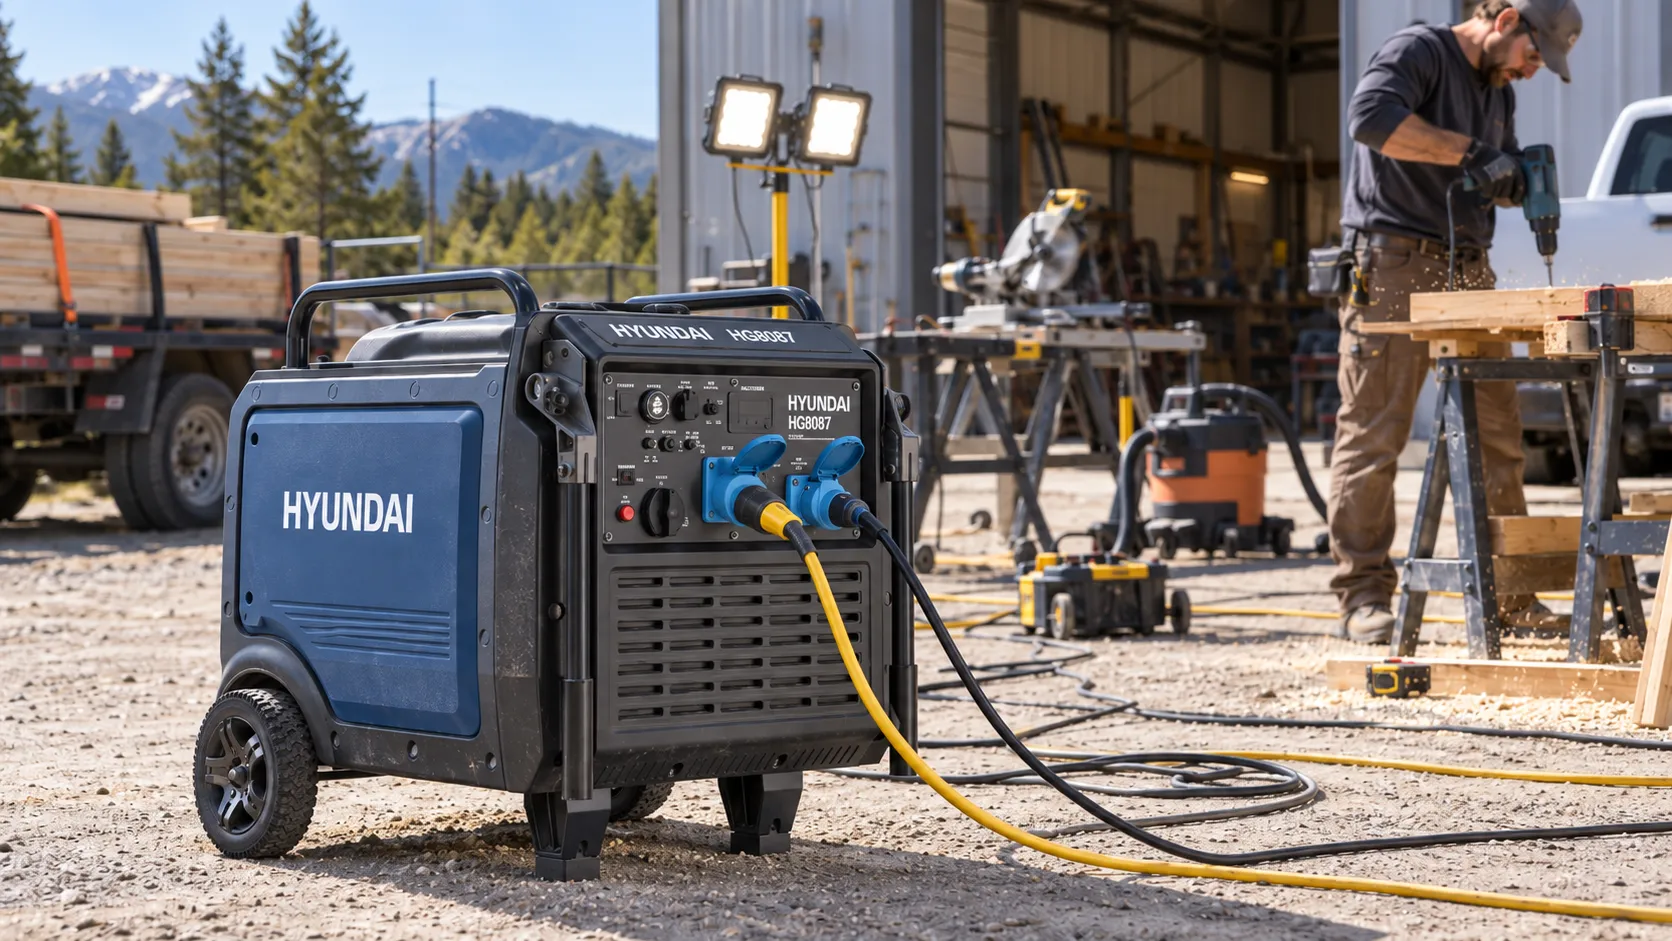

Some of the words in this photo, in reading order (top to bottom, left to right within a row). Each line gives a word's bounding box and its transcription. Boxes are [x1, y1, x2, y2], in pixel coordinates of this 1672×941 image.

[609, 323, 714, 341] HYUNDAI
[726, 328, 796, 344] HG8087
[788, 394, 851, 412] HYUNDAI
[788, 415, 832, 430] HG8087
[282, 490, 414, 533] HYUNDAI
